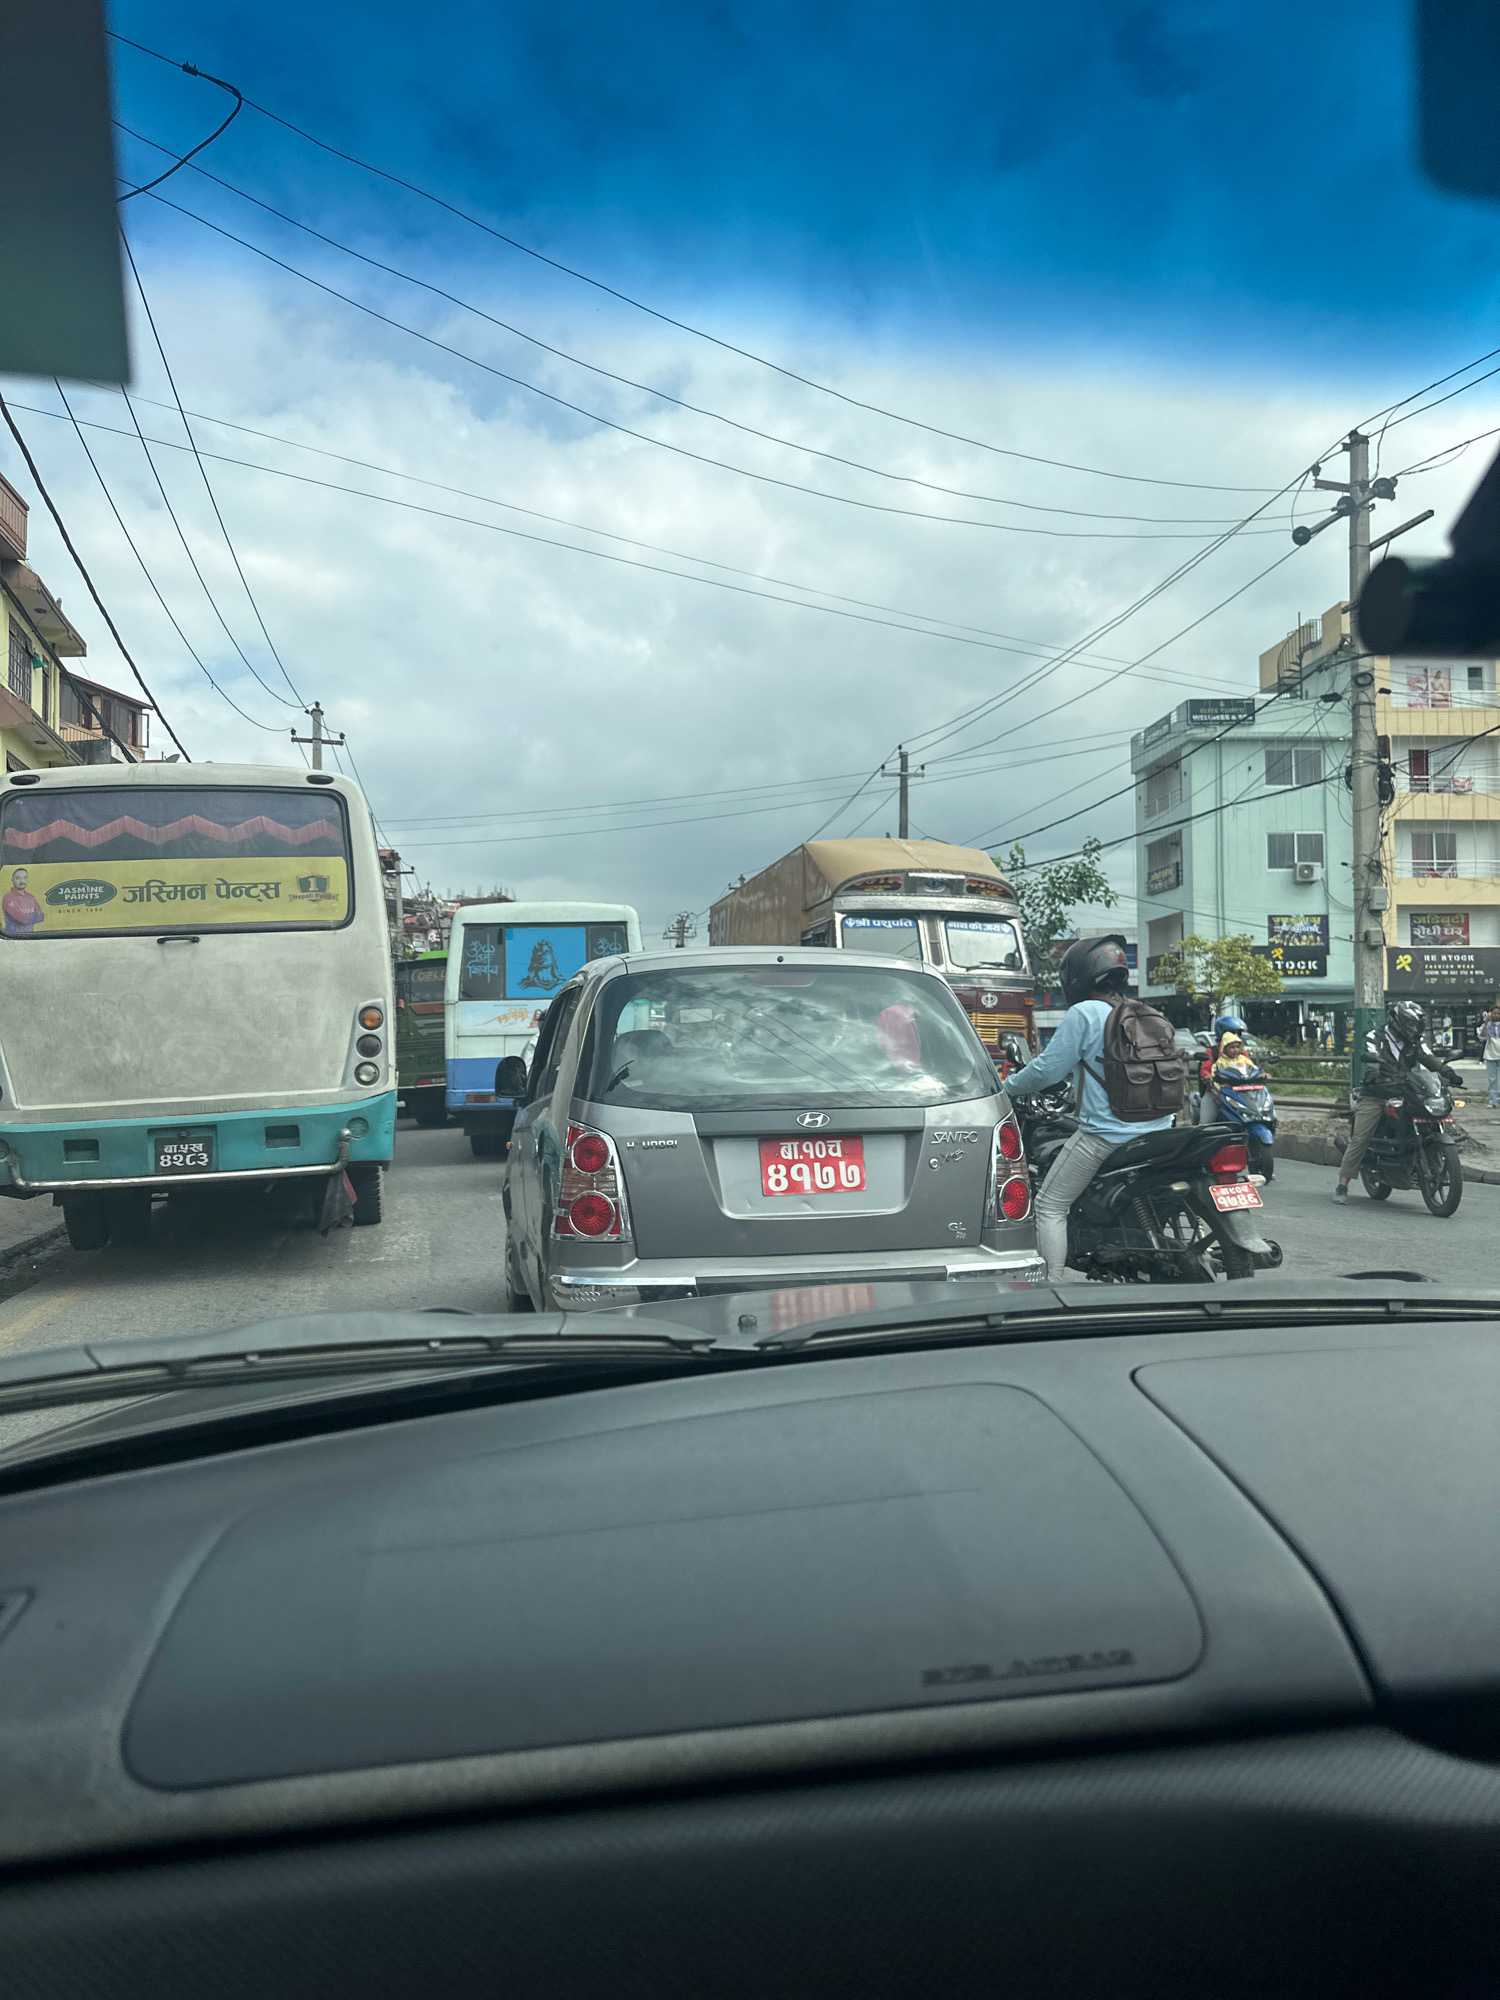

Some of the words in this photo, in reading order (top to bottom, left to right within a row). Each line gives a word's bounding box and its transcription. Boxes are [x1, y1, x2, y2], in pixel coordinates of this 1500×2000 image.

[58, 886, 104, 895] JASMINE
[64, 892, 100, 900] PAINTS
[122, 879, 208, 903] जस्मिन
[214, 877, 281, 902] पेन्ट्स
[1441, 954, 1474, 962] STOCK
[931, 1131, 978, 1144] SANTRO
[160, 1153, 209, 1167] ४२८३
[767, 1161, 860, 1192] ४१७७
